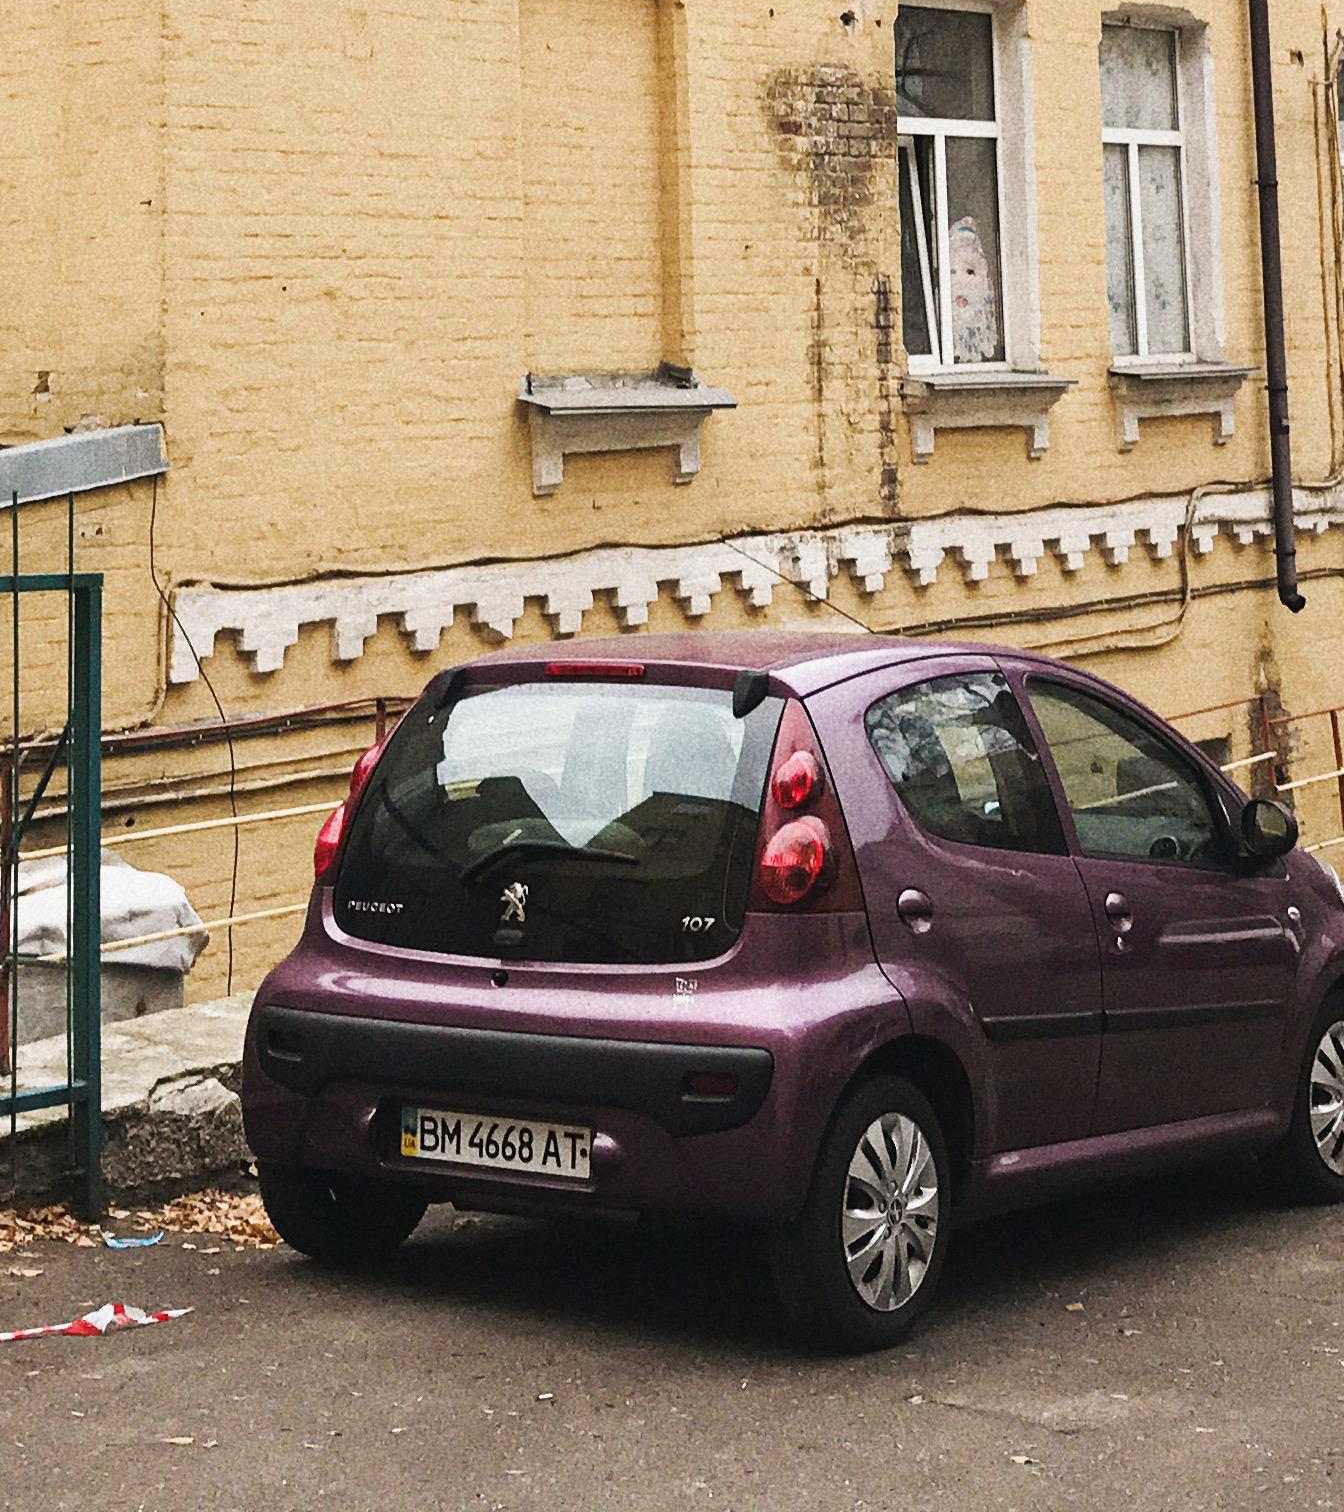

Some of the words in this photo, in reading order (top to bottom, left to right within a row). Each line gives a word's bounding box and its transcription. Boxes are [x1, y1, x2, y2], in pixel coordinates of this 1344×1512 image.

[347, 900, 404, 914] PEUGEOT
[682, 915, 716, 933] 107
[419, 1115, 462, 1155] BM
[468, 1122, 534, 1163] 4668
[541, 1130, 584, 1169] AT
